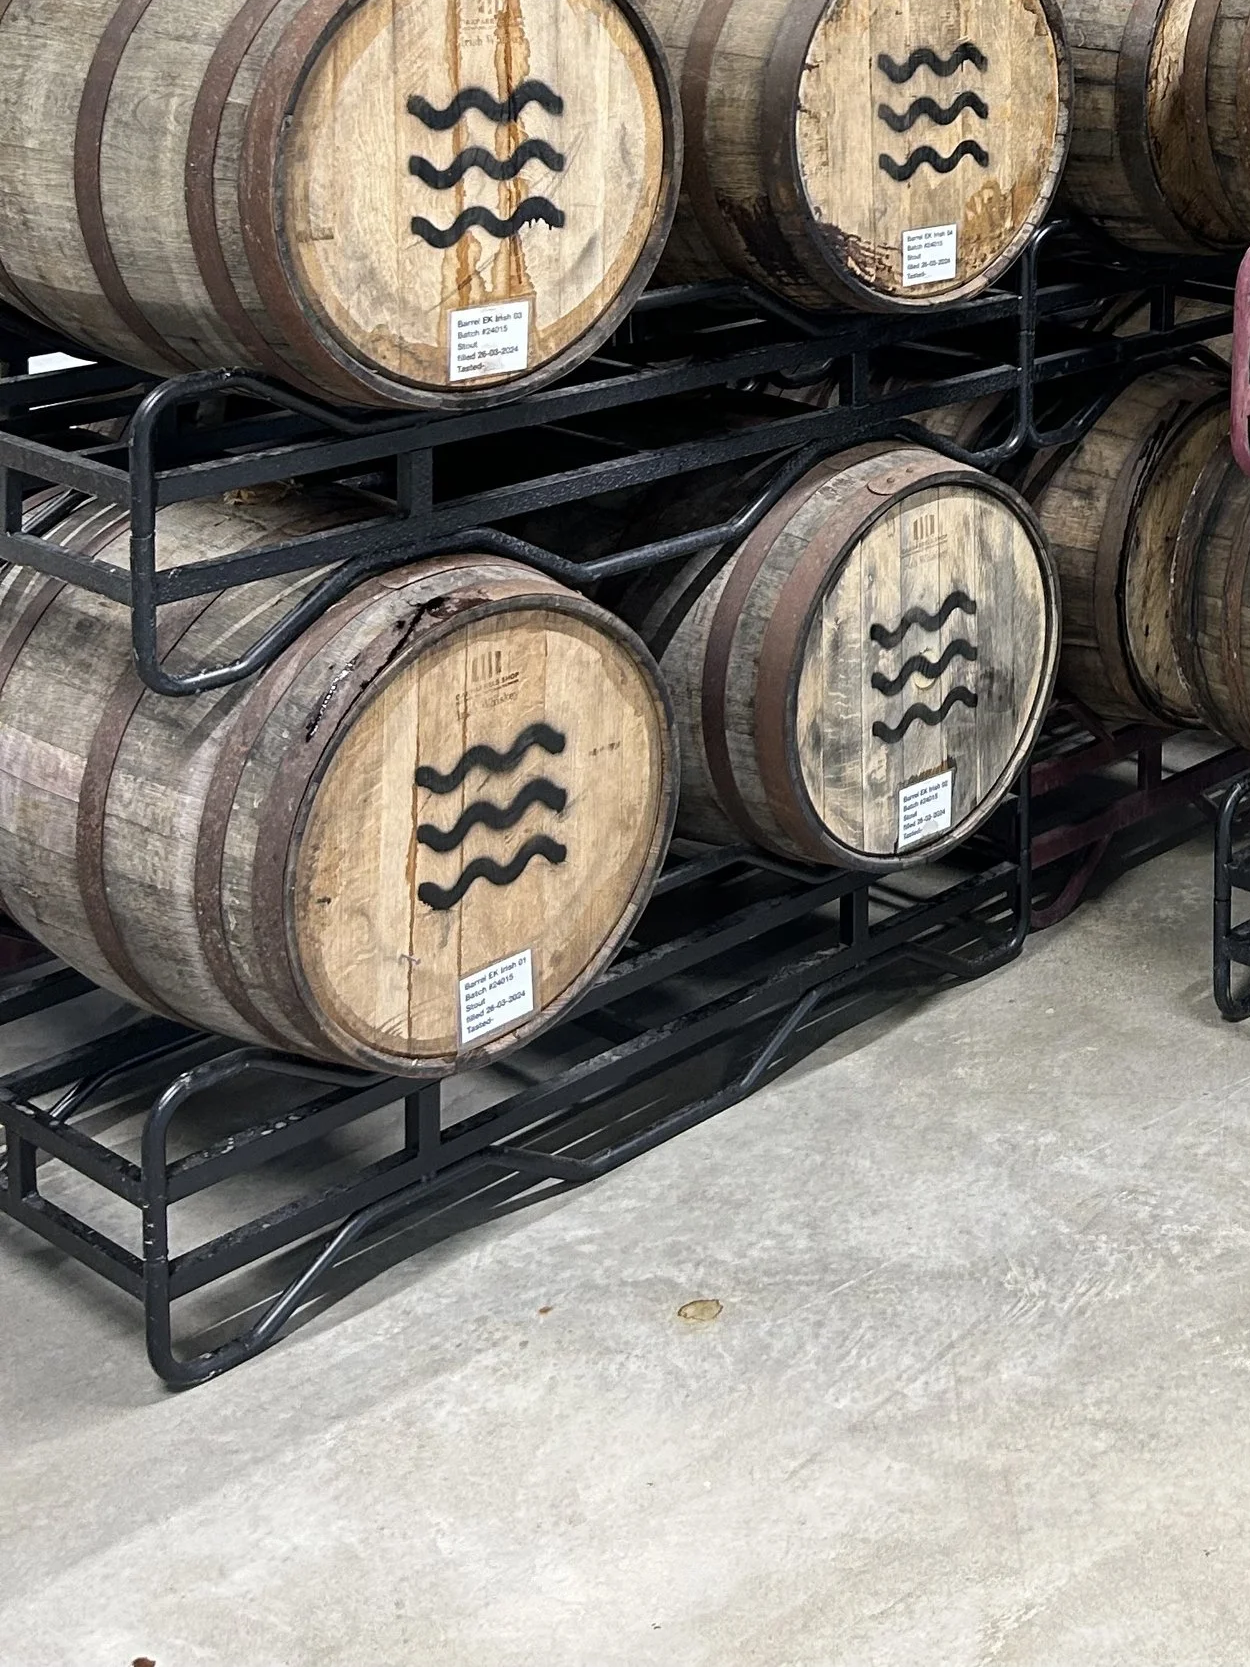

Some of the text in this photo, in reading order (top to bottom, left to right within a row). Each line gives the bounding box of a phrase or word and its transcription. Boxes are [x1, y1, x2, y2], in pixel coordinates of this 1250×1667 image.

[457, 318, 480, 328] Barrel
[495, 314, 511, 323] Irish
[513, 312, 522, 320] 03
[457, 325, 508, 339] Batch #24015
[457, 342, 478, 350] Stout
[457, 346, 518, 361] filled 26-03-2024
[501, 672, 519, 683] SHOP
[464, 975, 487, 990] Barrel
[501, 962, 516, 974] Irish
[518, 957, 527, 966] 01
[465, 974, 514, 1001] Batch #24015
[466, 998, 486, 1012] Stout
[466, 1010, 485, 1023] filled
